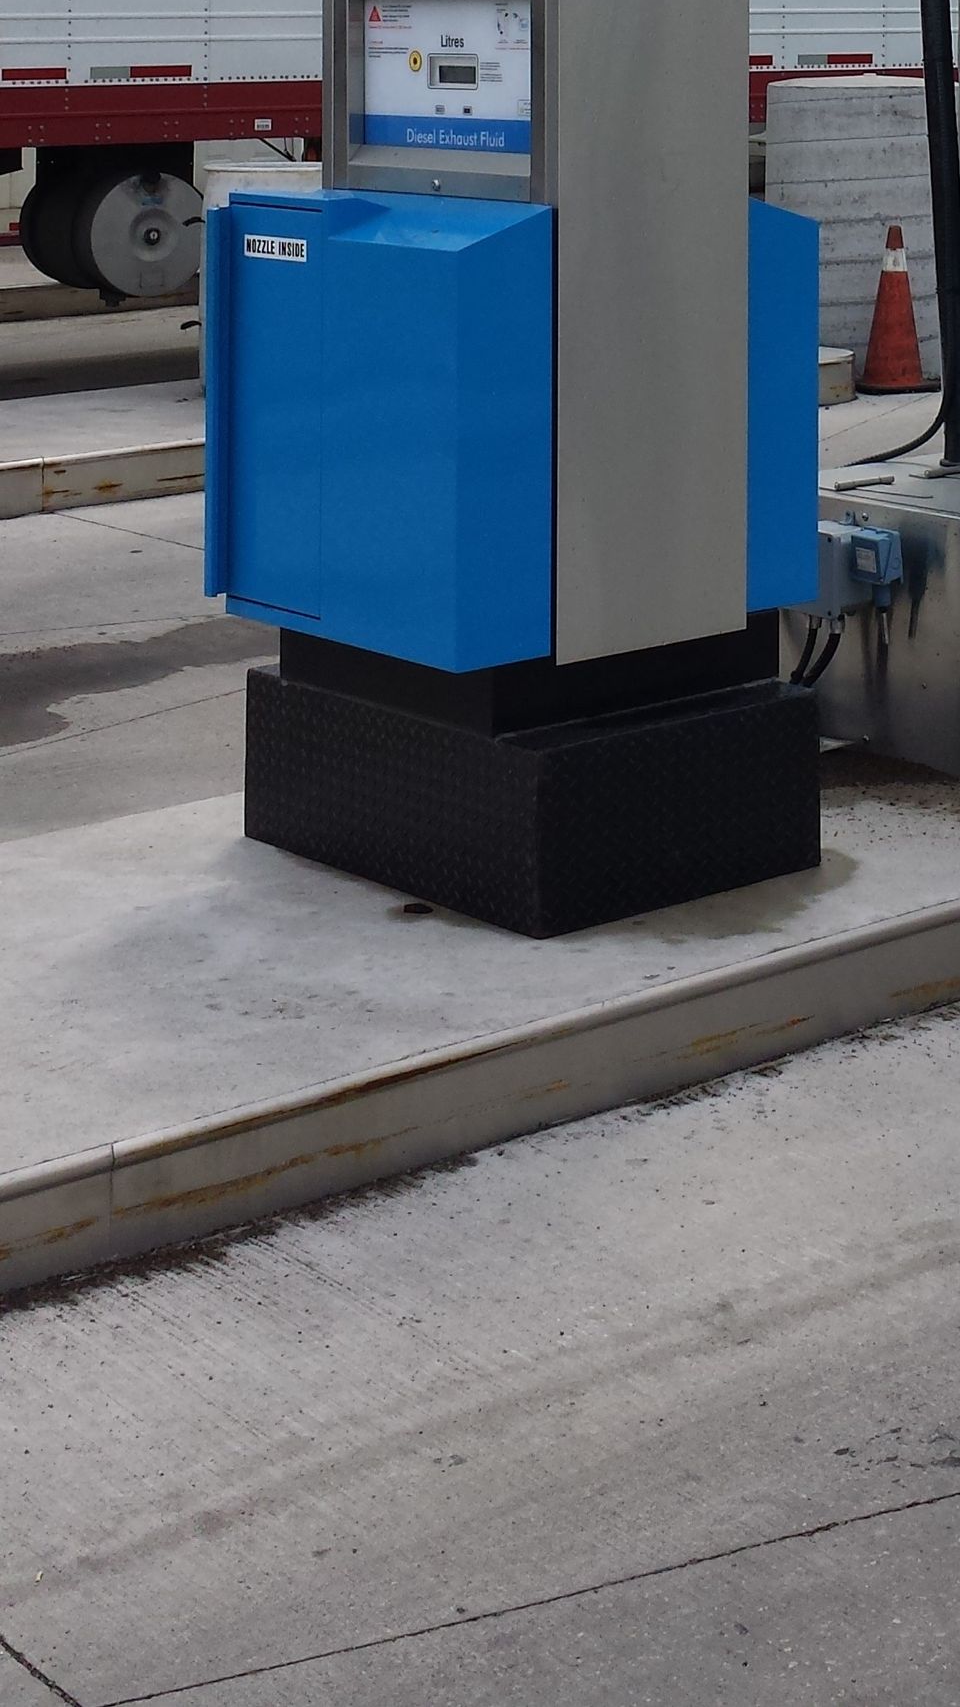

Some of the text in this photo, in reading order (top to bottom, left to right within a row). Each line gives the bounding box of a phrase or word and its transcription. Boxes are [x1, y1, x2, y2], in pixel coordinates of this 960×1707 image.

[440, 34, 465, 49] Litres
[406, 127, 505, 148] Diesel Exhaust Fluid
[246, 237, 305, 258] NOZZLE INSIDE
